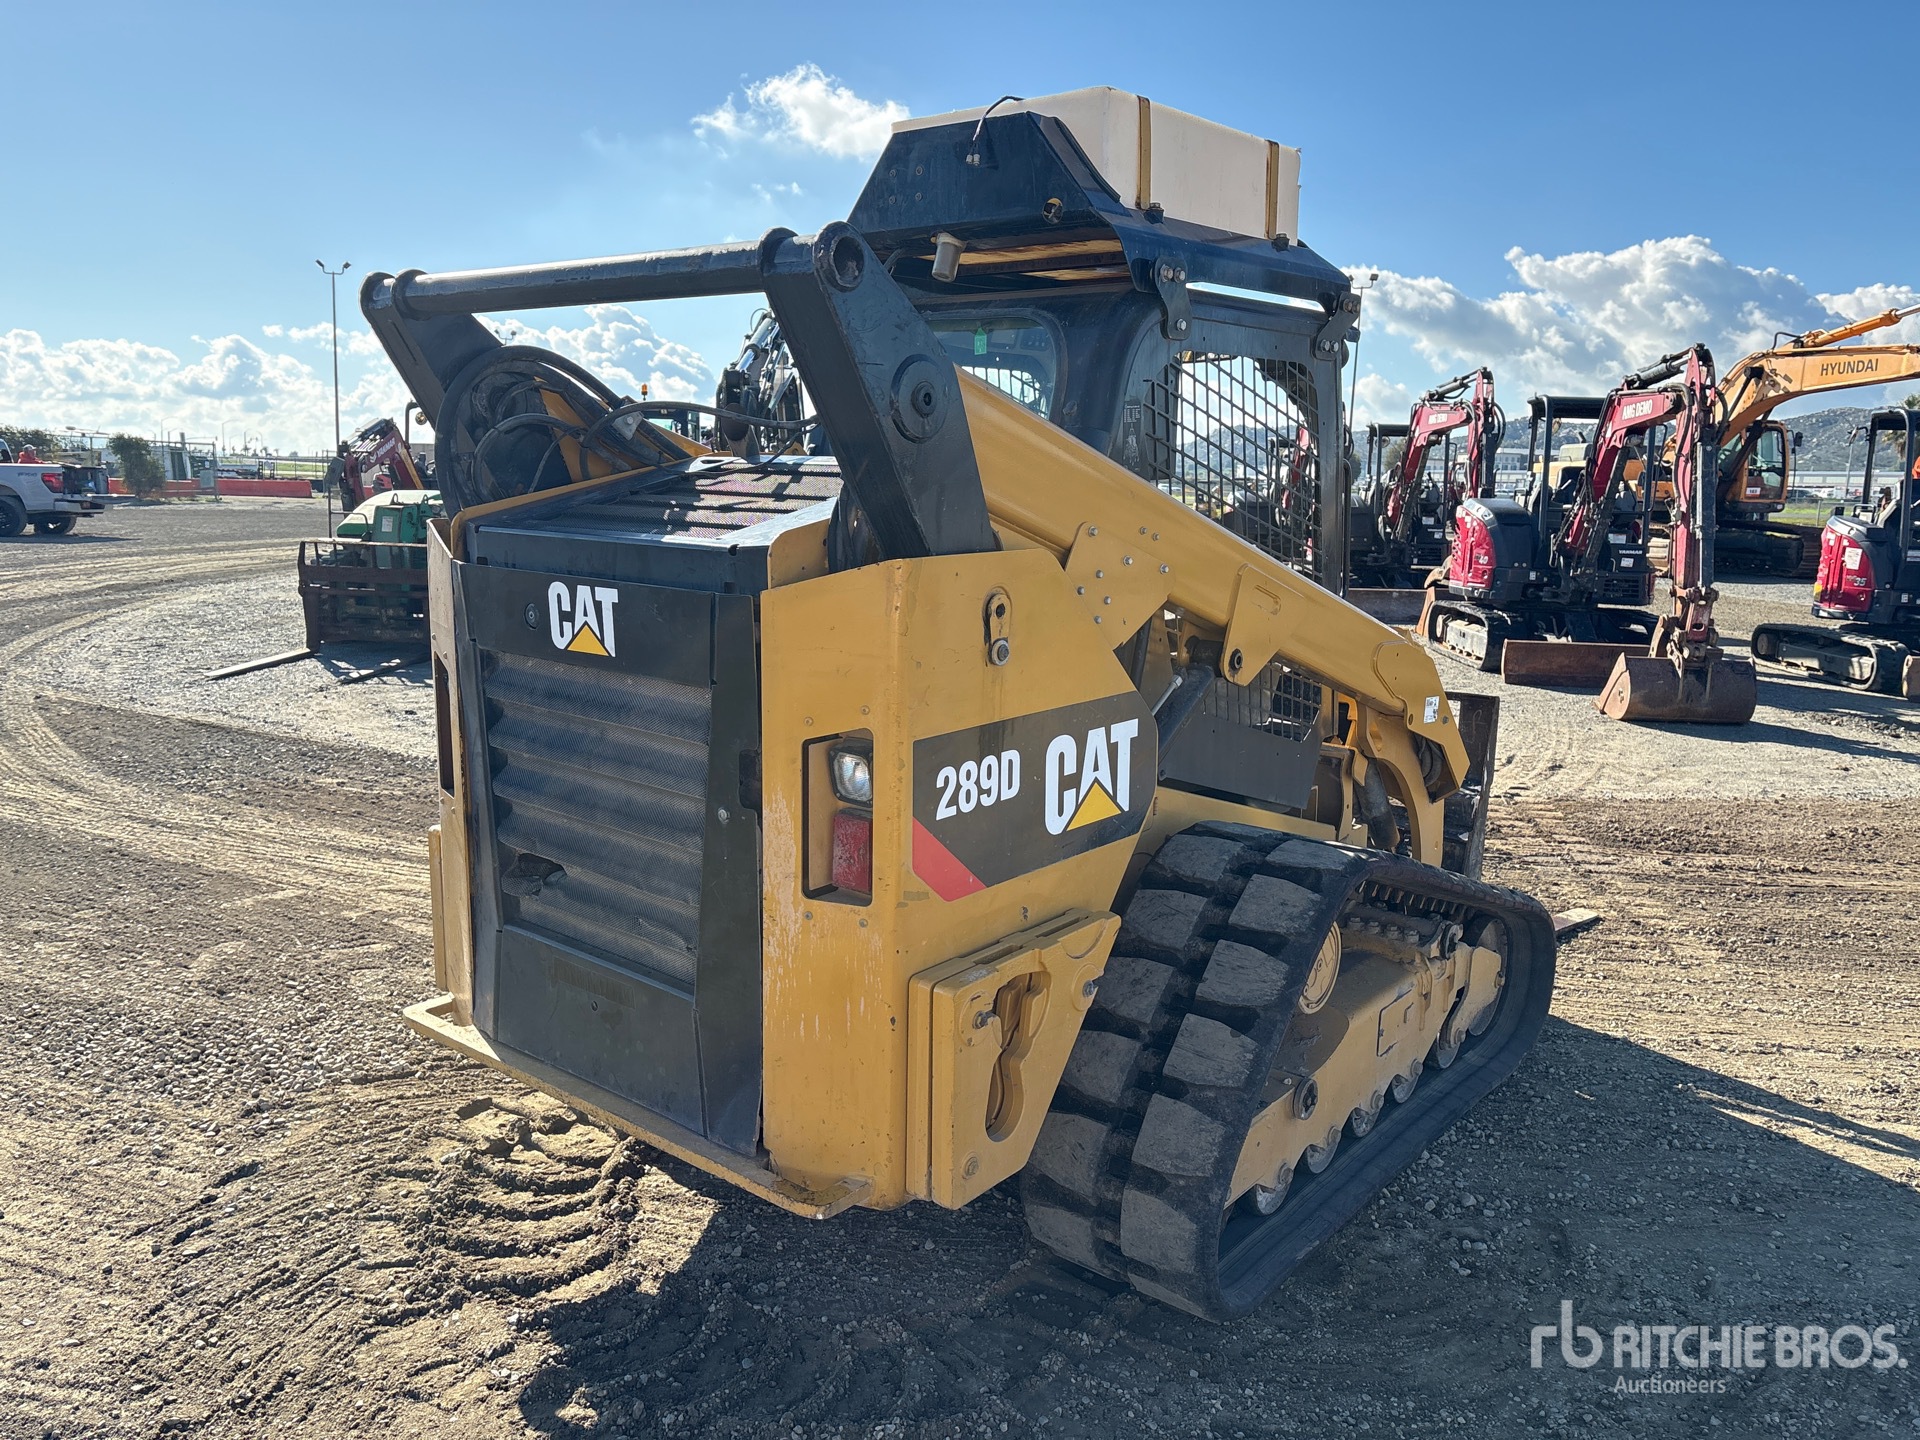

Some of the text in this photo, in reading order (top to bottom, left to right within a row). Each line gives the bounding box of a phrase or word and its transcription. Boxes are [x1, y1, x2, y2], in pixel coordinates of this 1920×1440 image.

[1820, 358, 1879, 376] HYUNDAI
[1622, 399, 1653, 420] AMG DEMO
[1853, 577, 1868, 587] 35
[548, 581, 619, 657] CAT
[935, 749, 1021, 821] 289D
[1044, 718, 1139, 836] CAT
